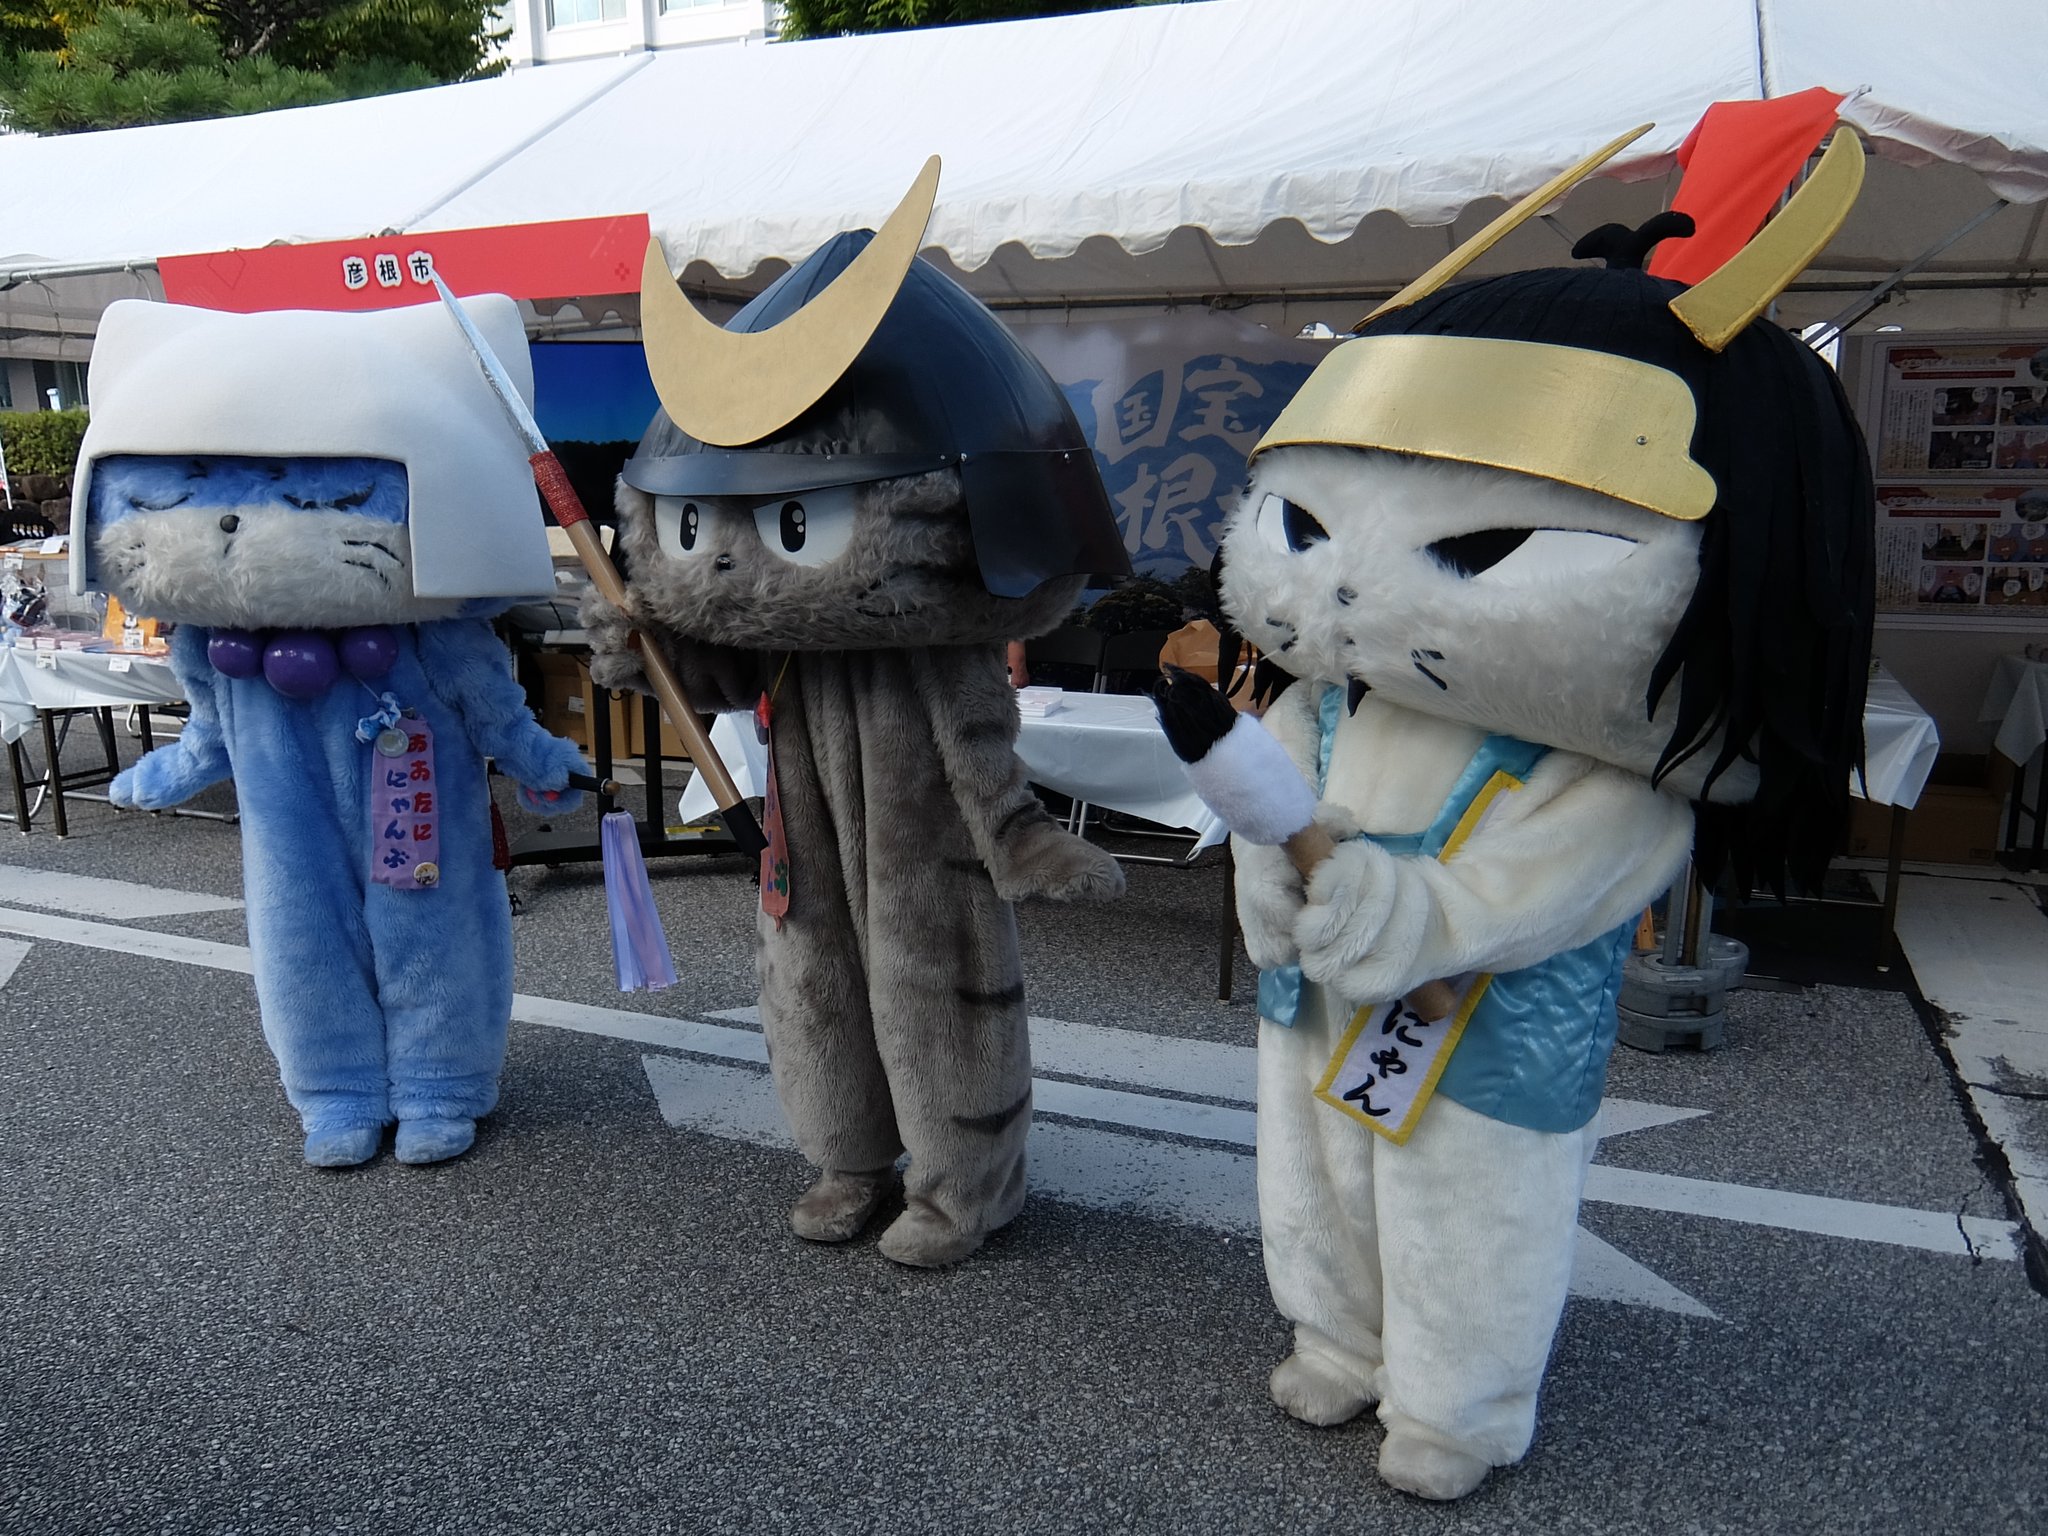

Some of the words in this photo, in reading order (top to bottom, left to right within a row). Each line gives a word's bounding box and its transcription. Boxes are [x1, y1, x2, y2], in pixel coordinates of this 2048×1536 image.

[345, 255, 431, 285] 彦根市
[1091, 355, 1264, 465] 国宝
[383, 769, 410, 869] にゃんぶ
[408, 733, 433, 841] おおたに
